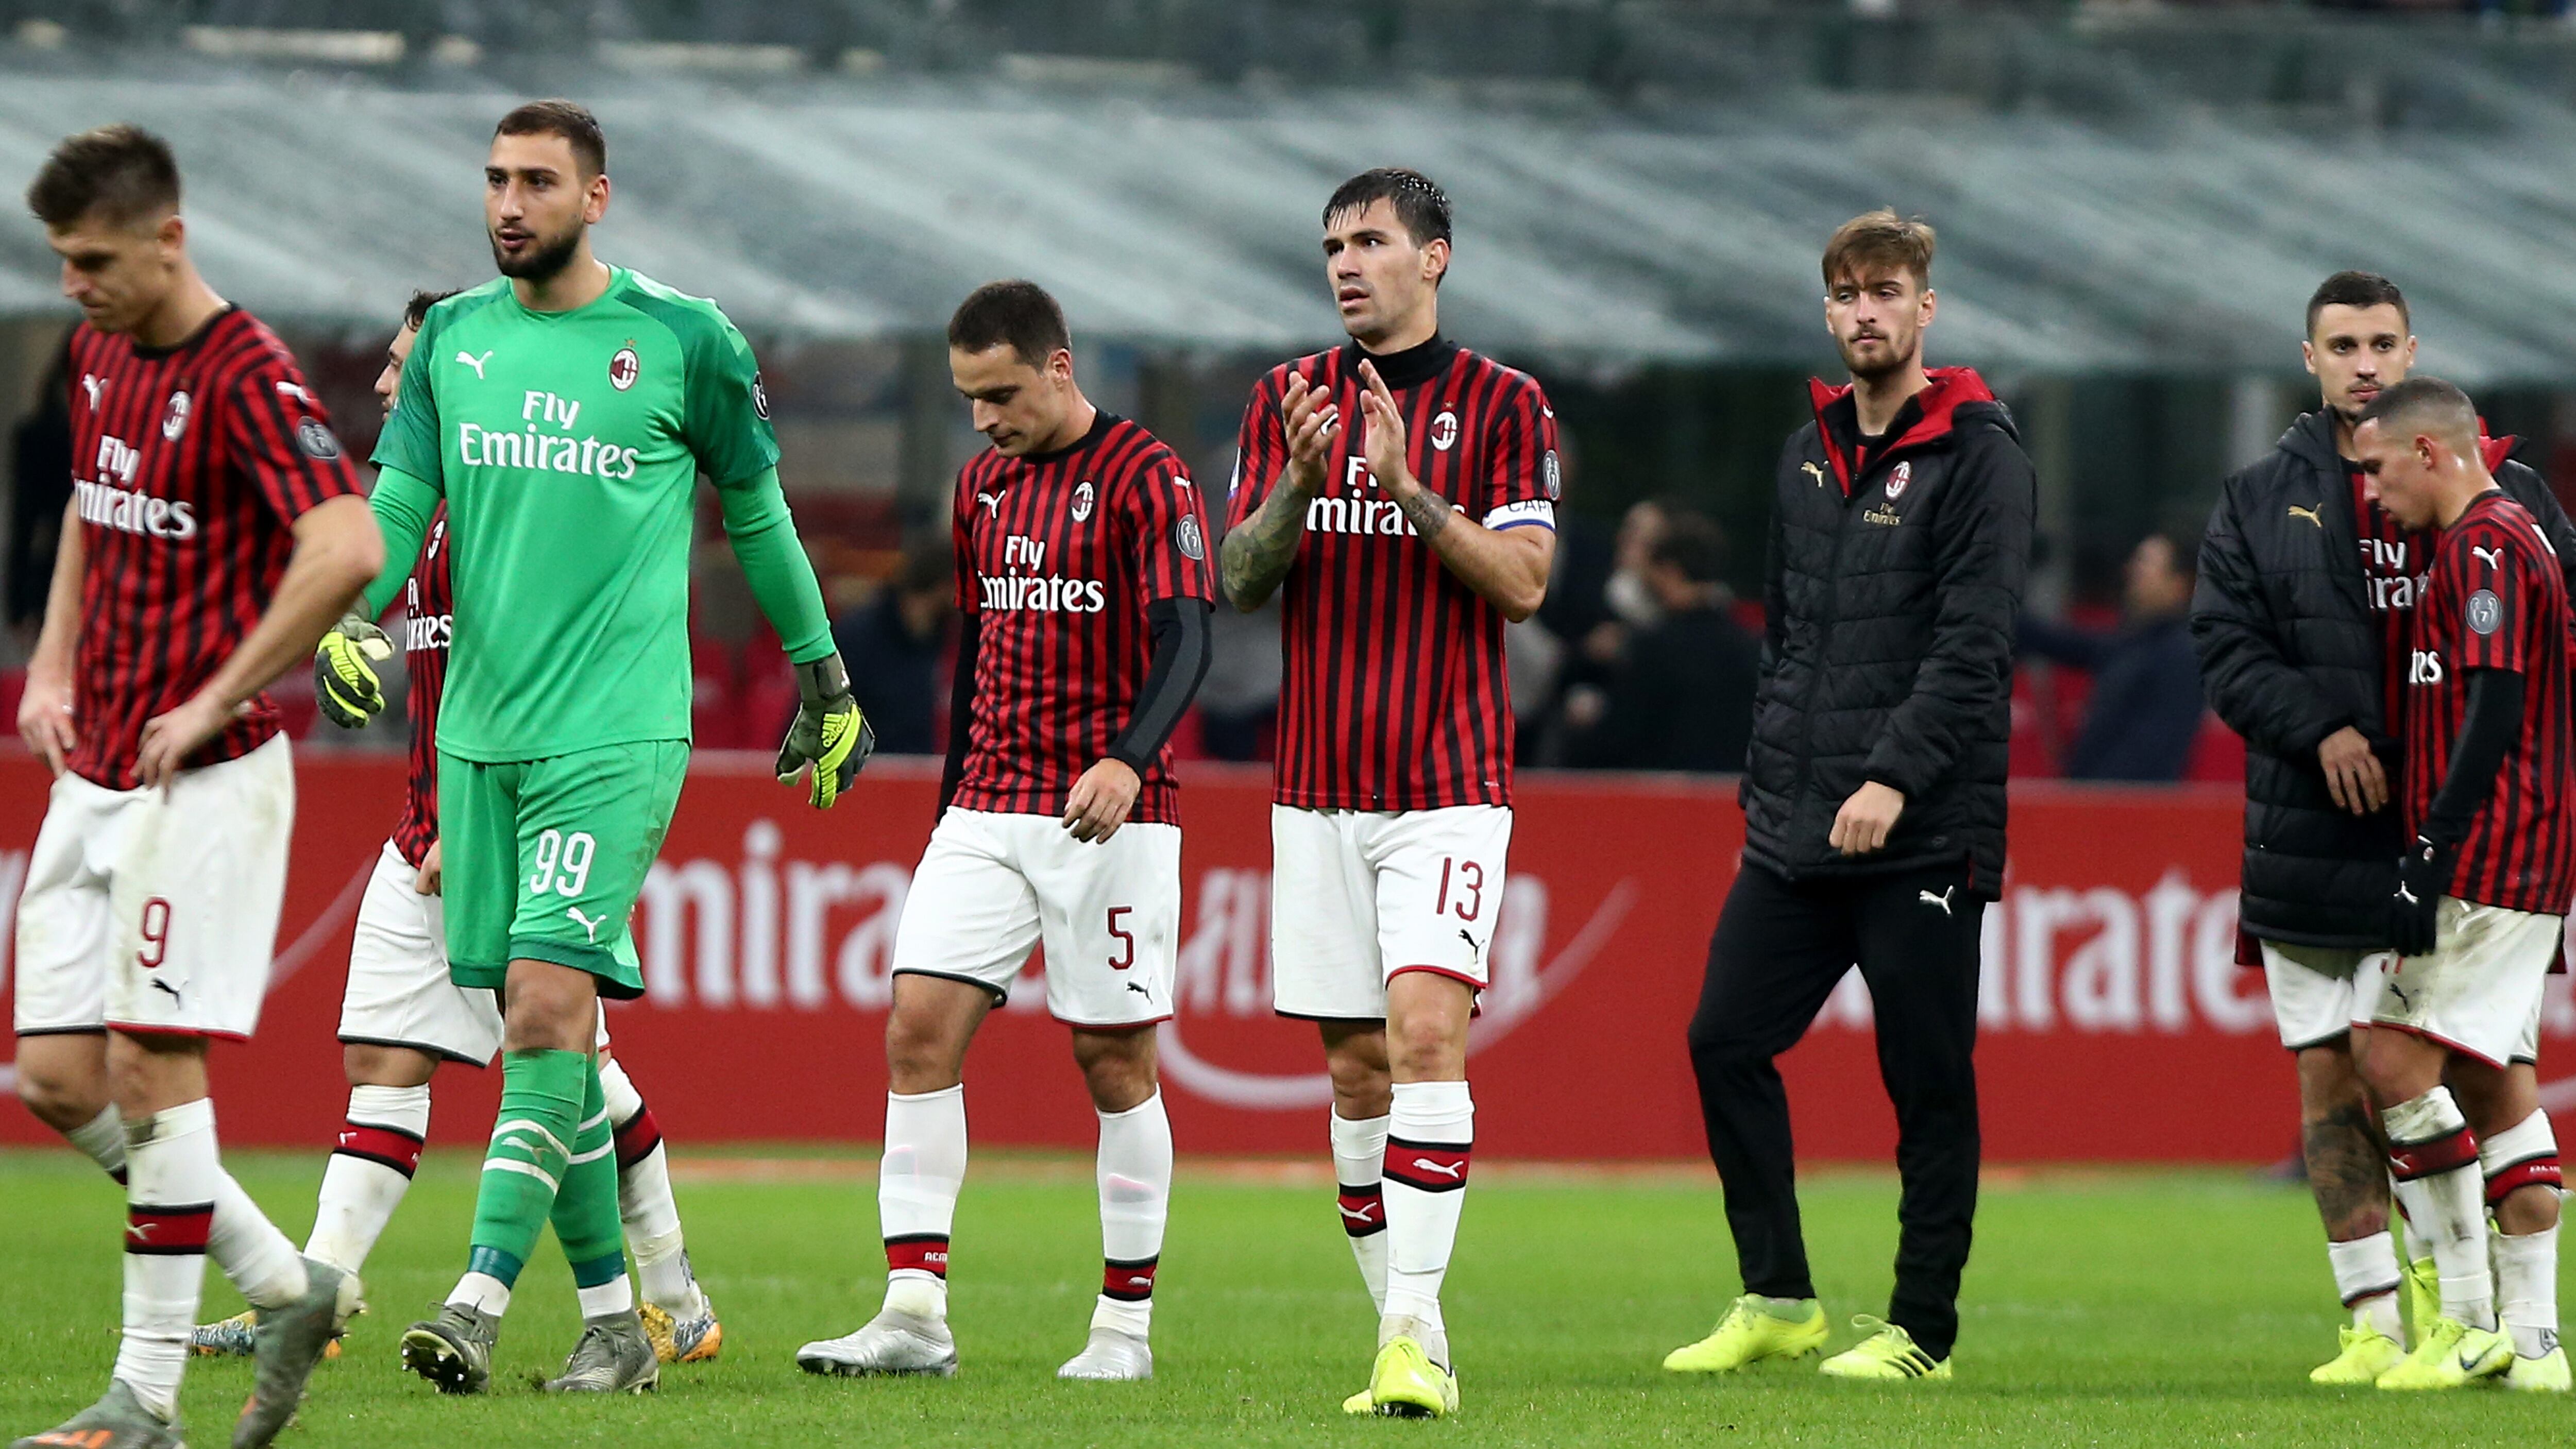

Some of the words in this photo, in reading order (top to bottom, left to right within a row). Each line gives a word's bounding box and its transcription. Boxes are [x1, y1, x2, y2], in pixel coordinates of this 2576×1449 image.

[521, 390, 580, 430] Fly
[97, 435, 140, 484] Fly
[459, 422, 638, 480] Emirates
[74, 478, 197, 540] mirates
[1004, 535, 1045, 570] Fly
[530, 829, 596, 897] 99
[1436, 857, 1483, 922] 13
[138, 896, 170, 967] 9
[1107, 906, 1134, 970] 5
